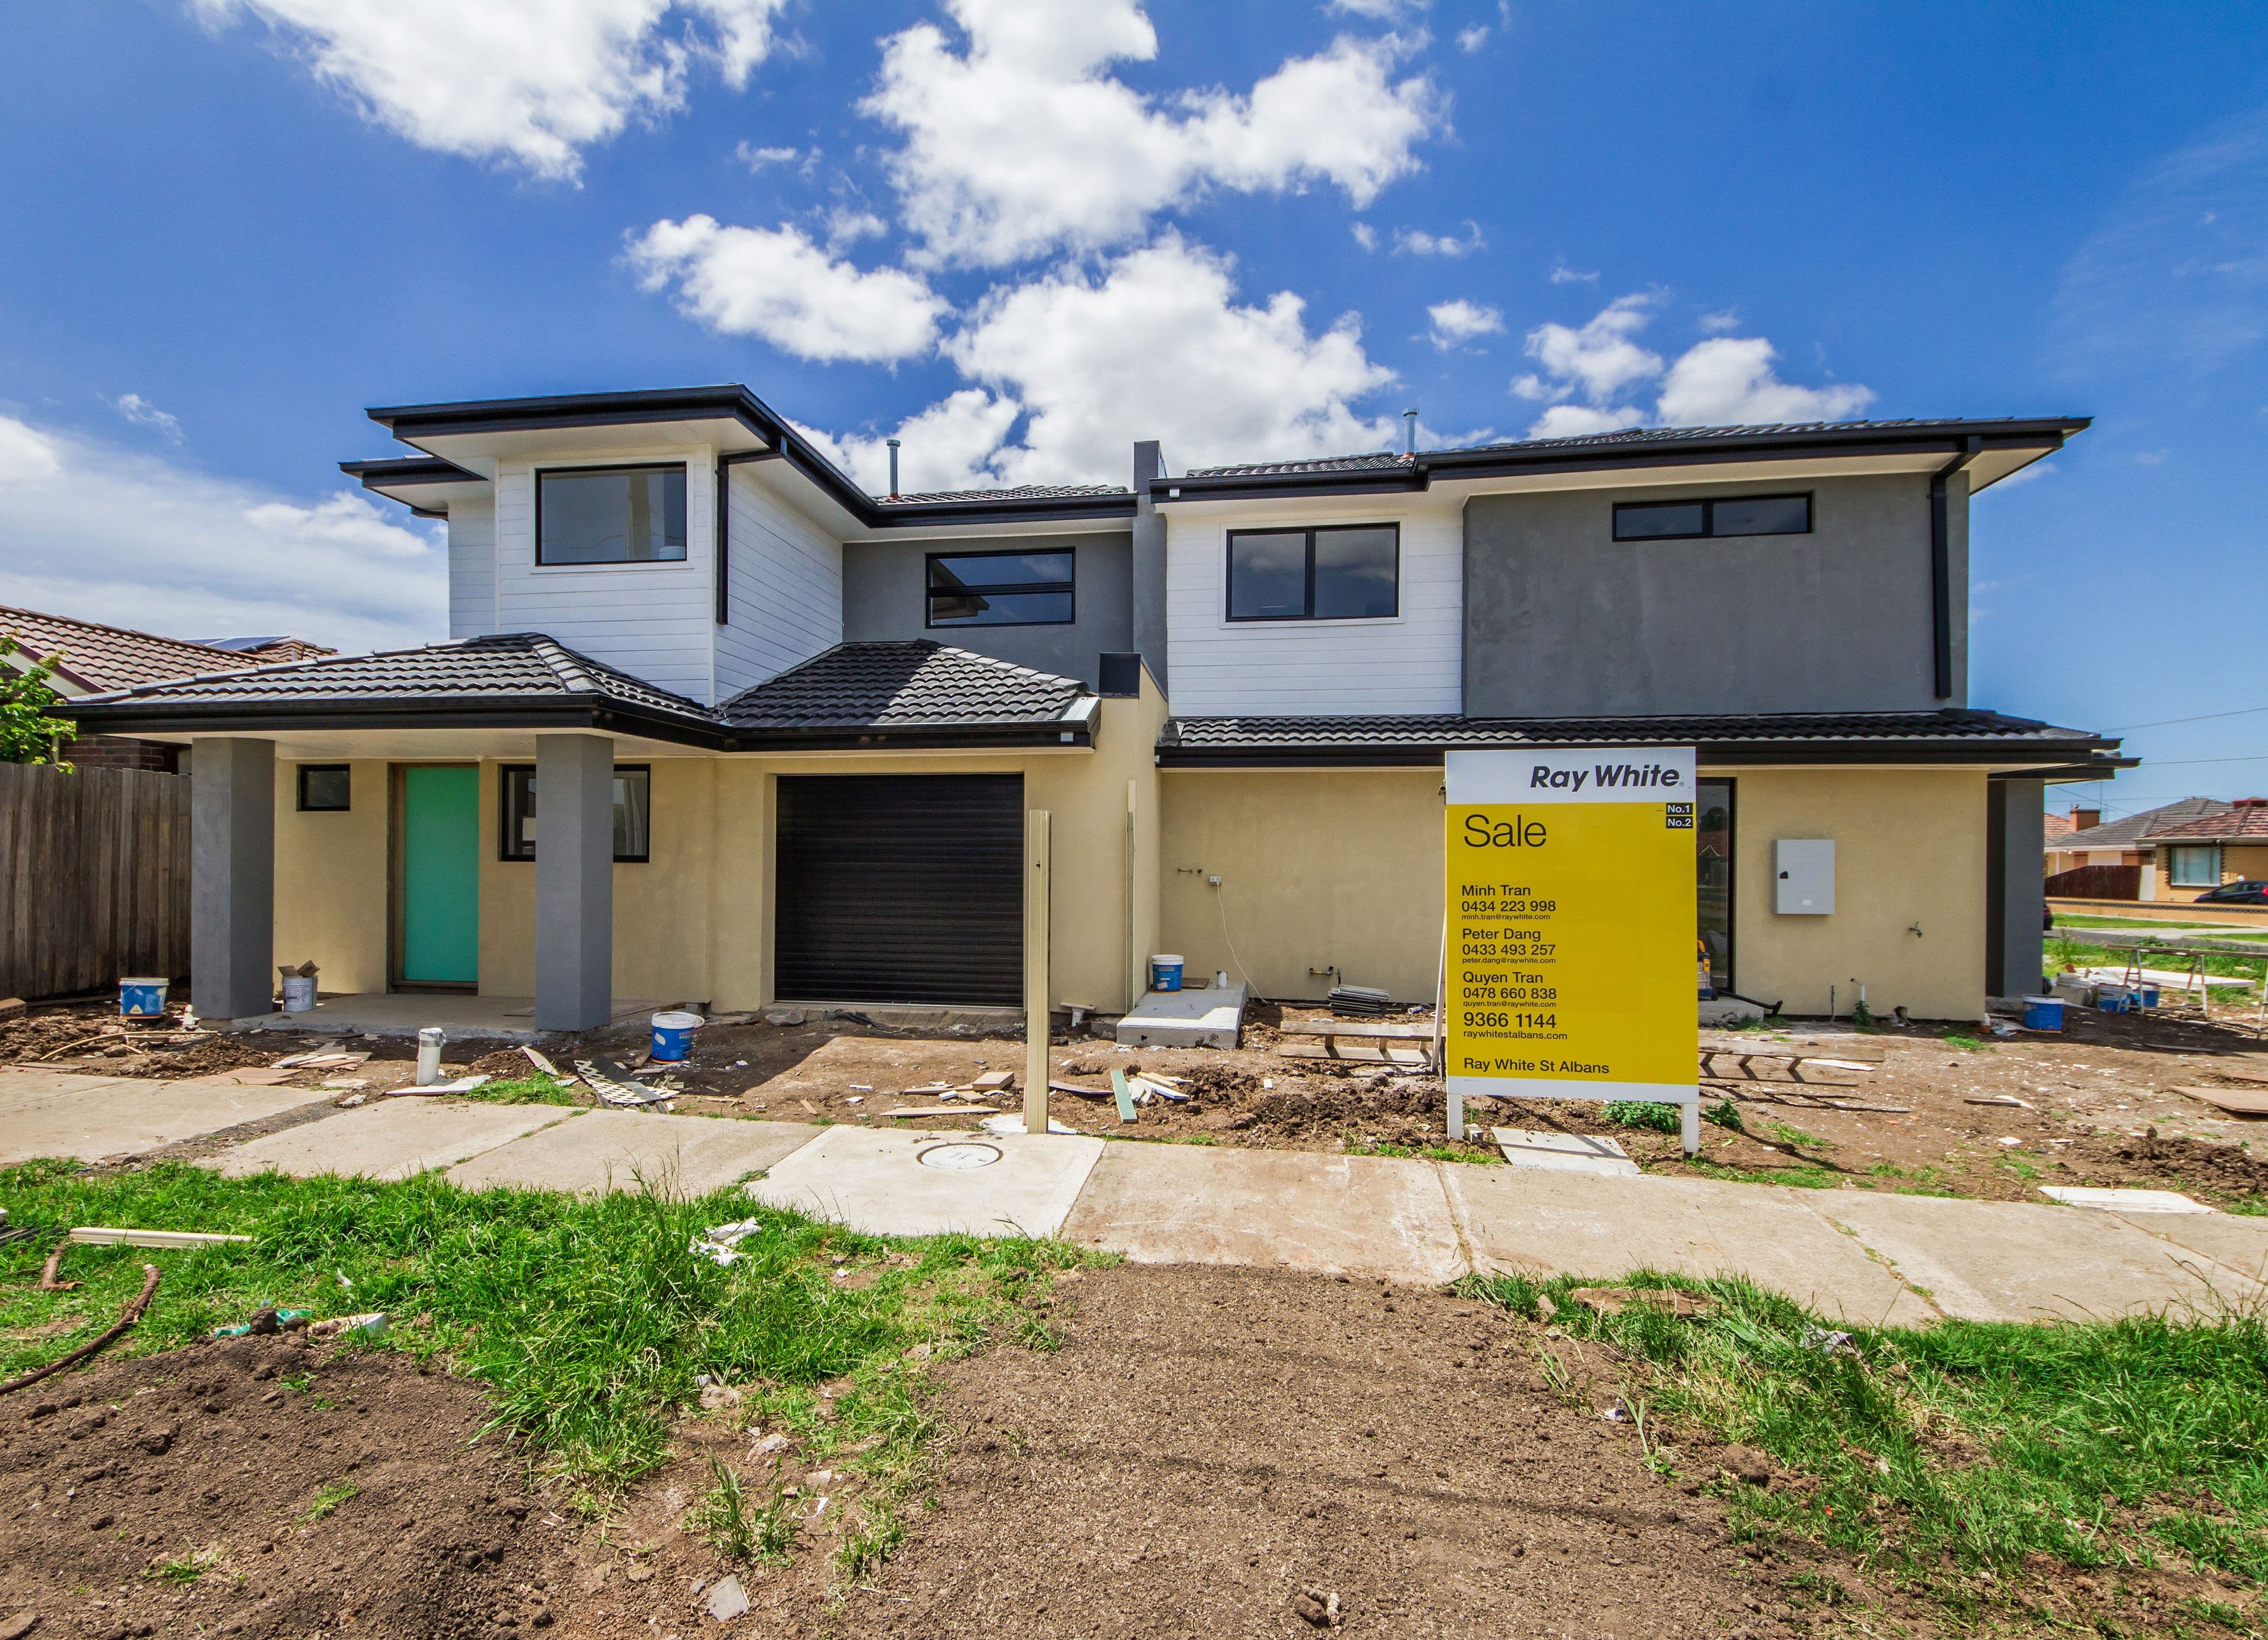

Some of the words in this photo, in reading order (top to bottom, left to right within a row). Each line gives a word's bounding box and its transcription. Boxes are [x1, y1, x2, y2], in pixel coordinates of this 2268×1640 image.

[1530, 766, 1589, 792] Ray
[1595, 764, 1680, 787] White
[1667, 805, 1690, 813] No.1
[1667, 818, 1692, 826] No.2
[1464, 814, 1547, 848] Sale
[1462, 884, 1495, 896] Minh
[1500, 884, 1531, 896] Tran
[1462, 900, 1496, 912] 0434
[1500, 900, 1526, 912] 223
[1530, 900, 1556, 912] 998
[1462, 928, 1500, 939] Peter
[1504, 928, 1541, 942] Dang
[1462, 943, 1496, 955] 0433
[1500, 943, 1526, 955] 493
[1531, 944, 1556, 955] 257
[1462, 971, 1508, 985] Quyen
[1512, 971, 1543, 983] Tran
[1463, 987, 1496, 999] 0478
[1500, 987, 1526, 999] 660
[1530, 988, 1557, 1000] 838
[1464, 1011, 1509, 1027] 9366
[1515, 1013, 1557, 1029] 1144
[1463, 1030, 1568, 1040] raywhitestalbans.com
[1464, 1057, 1491, 1072] Ray
[1494, 1058, 1535, 1071] White
[1540, 1060, 1555, 1072] St
[1559, 1060, 1609, 1074] Albans
